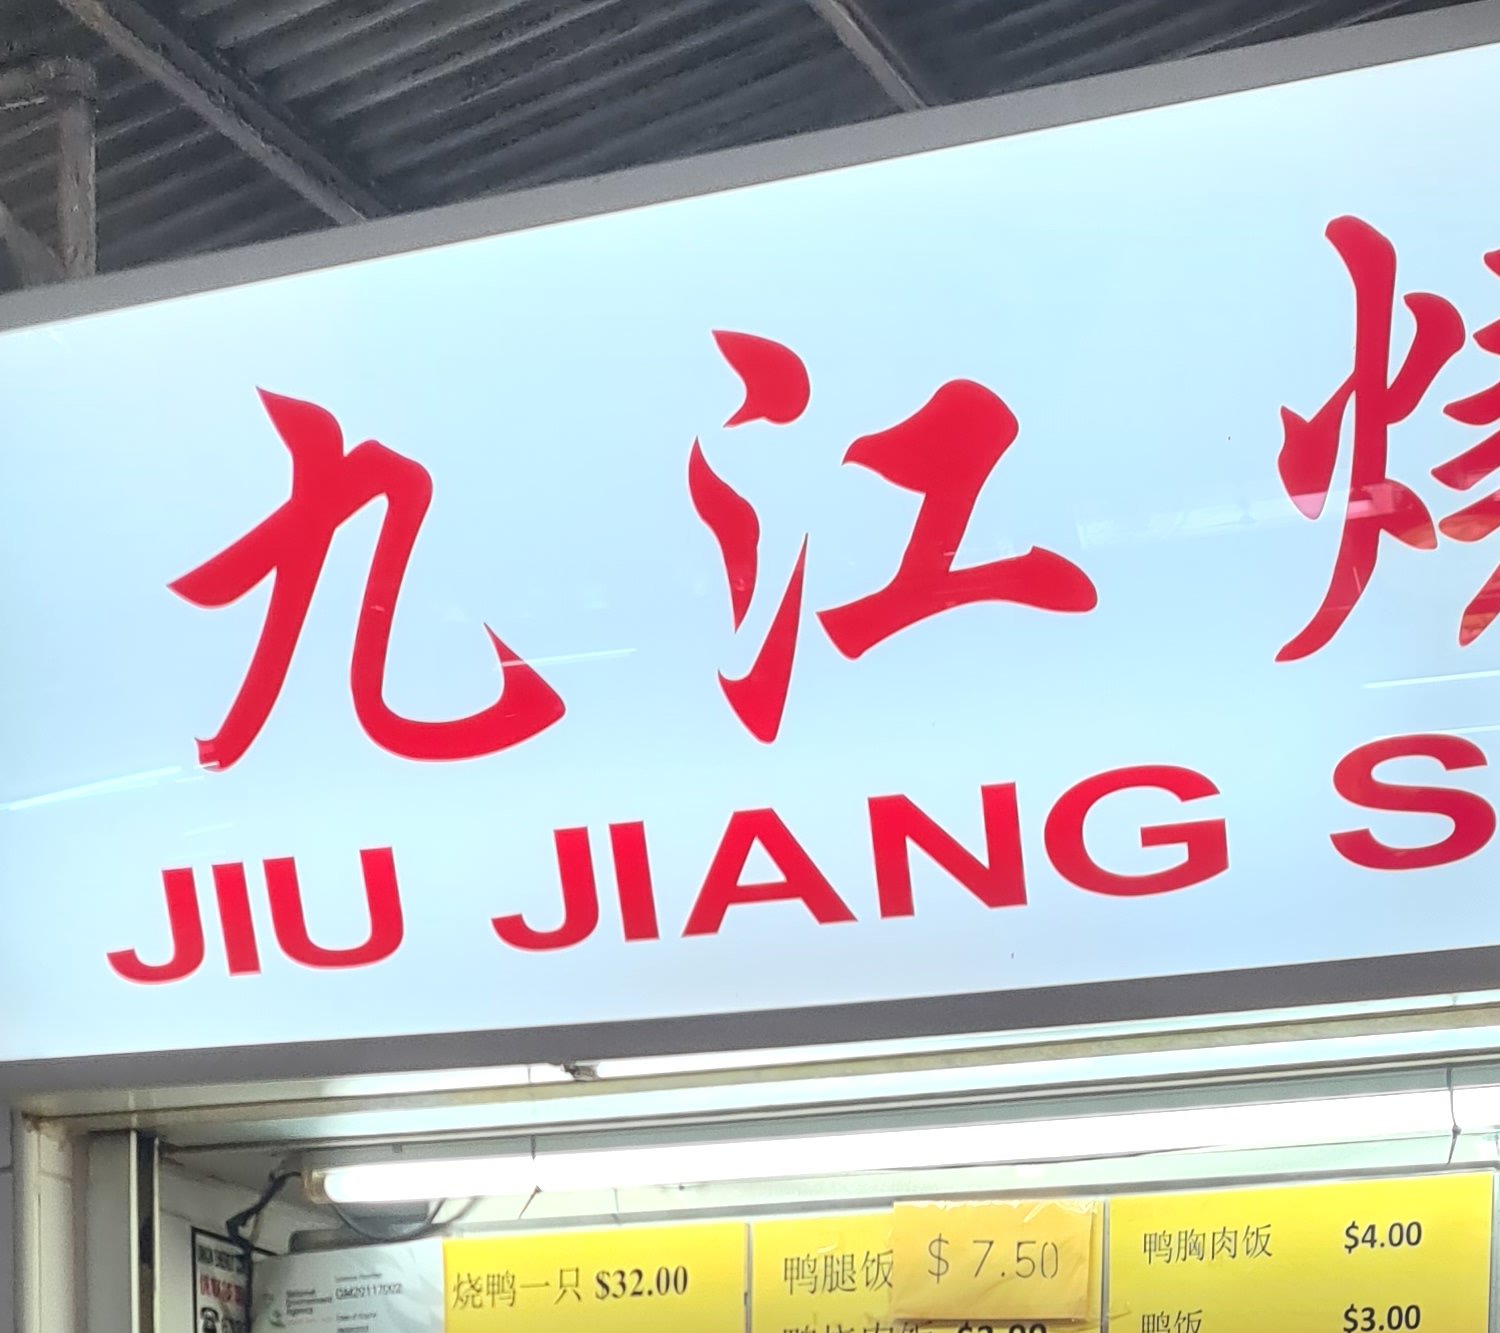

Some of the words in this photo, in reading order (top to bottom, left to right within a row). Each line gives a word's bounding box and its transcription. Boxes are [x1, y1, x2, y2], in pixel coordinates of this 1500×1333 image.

[108, 848, 404, 984] JIU
[491, 765, 1230, 952] JIANG
[1142, 1223, 1274, 1265] 鸭胸肉饭
[1344, 1221, 1423, 1255] $4.00
[452, 1266, 582, 1311] 烧鸭一只
[594, 1265, 689, 1300] $32.00
[783, 1250, 894, 1296] 鸭腿饭
